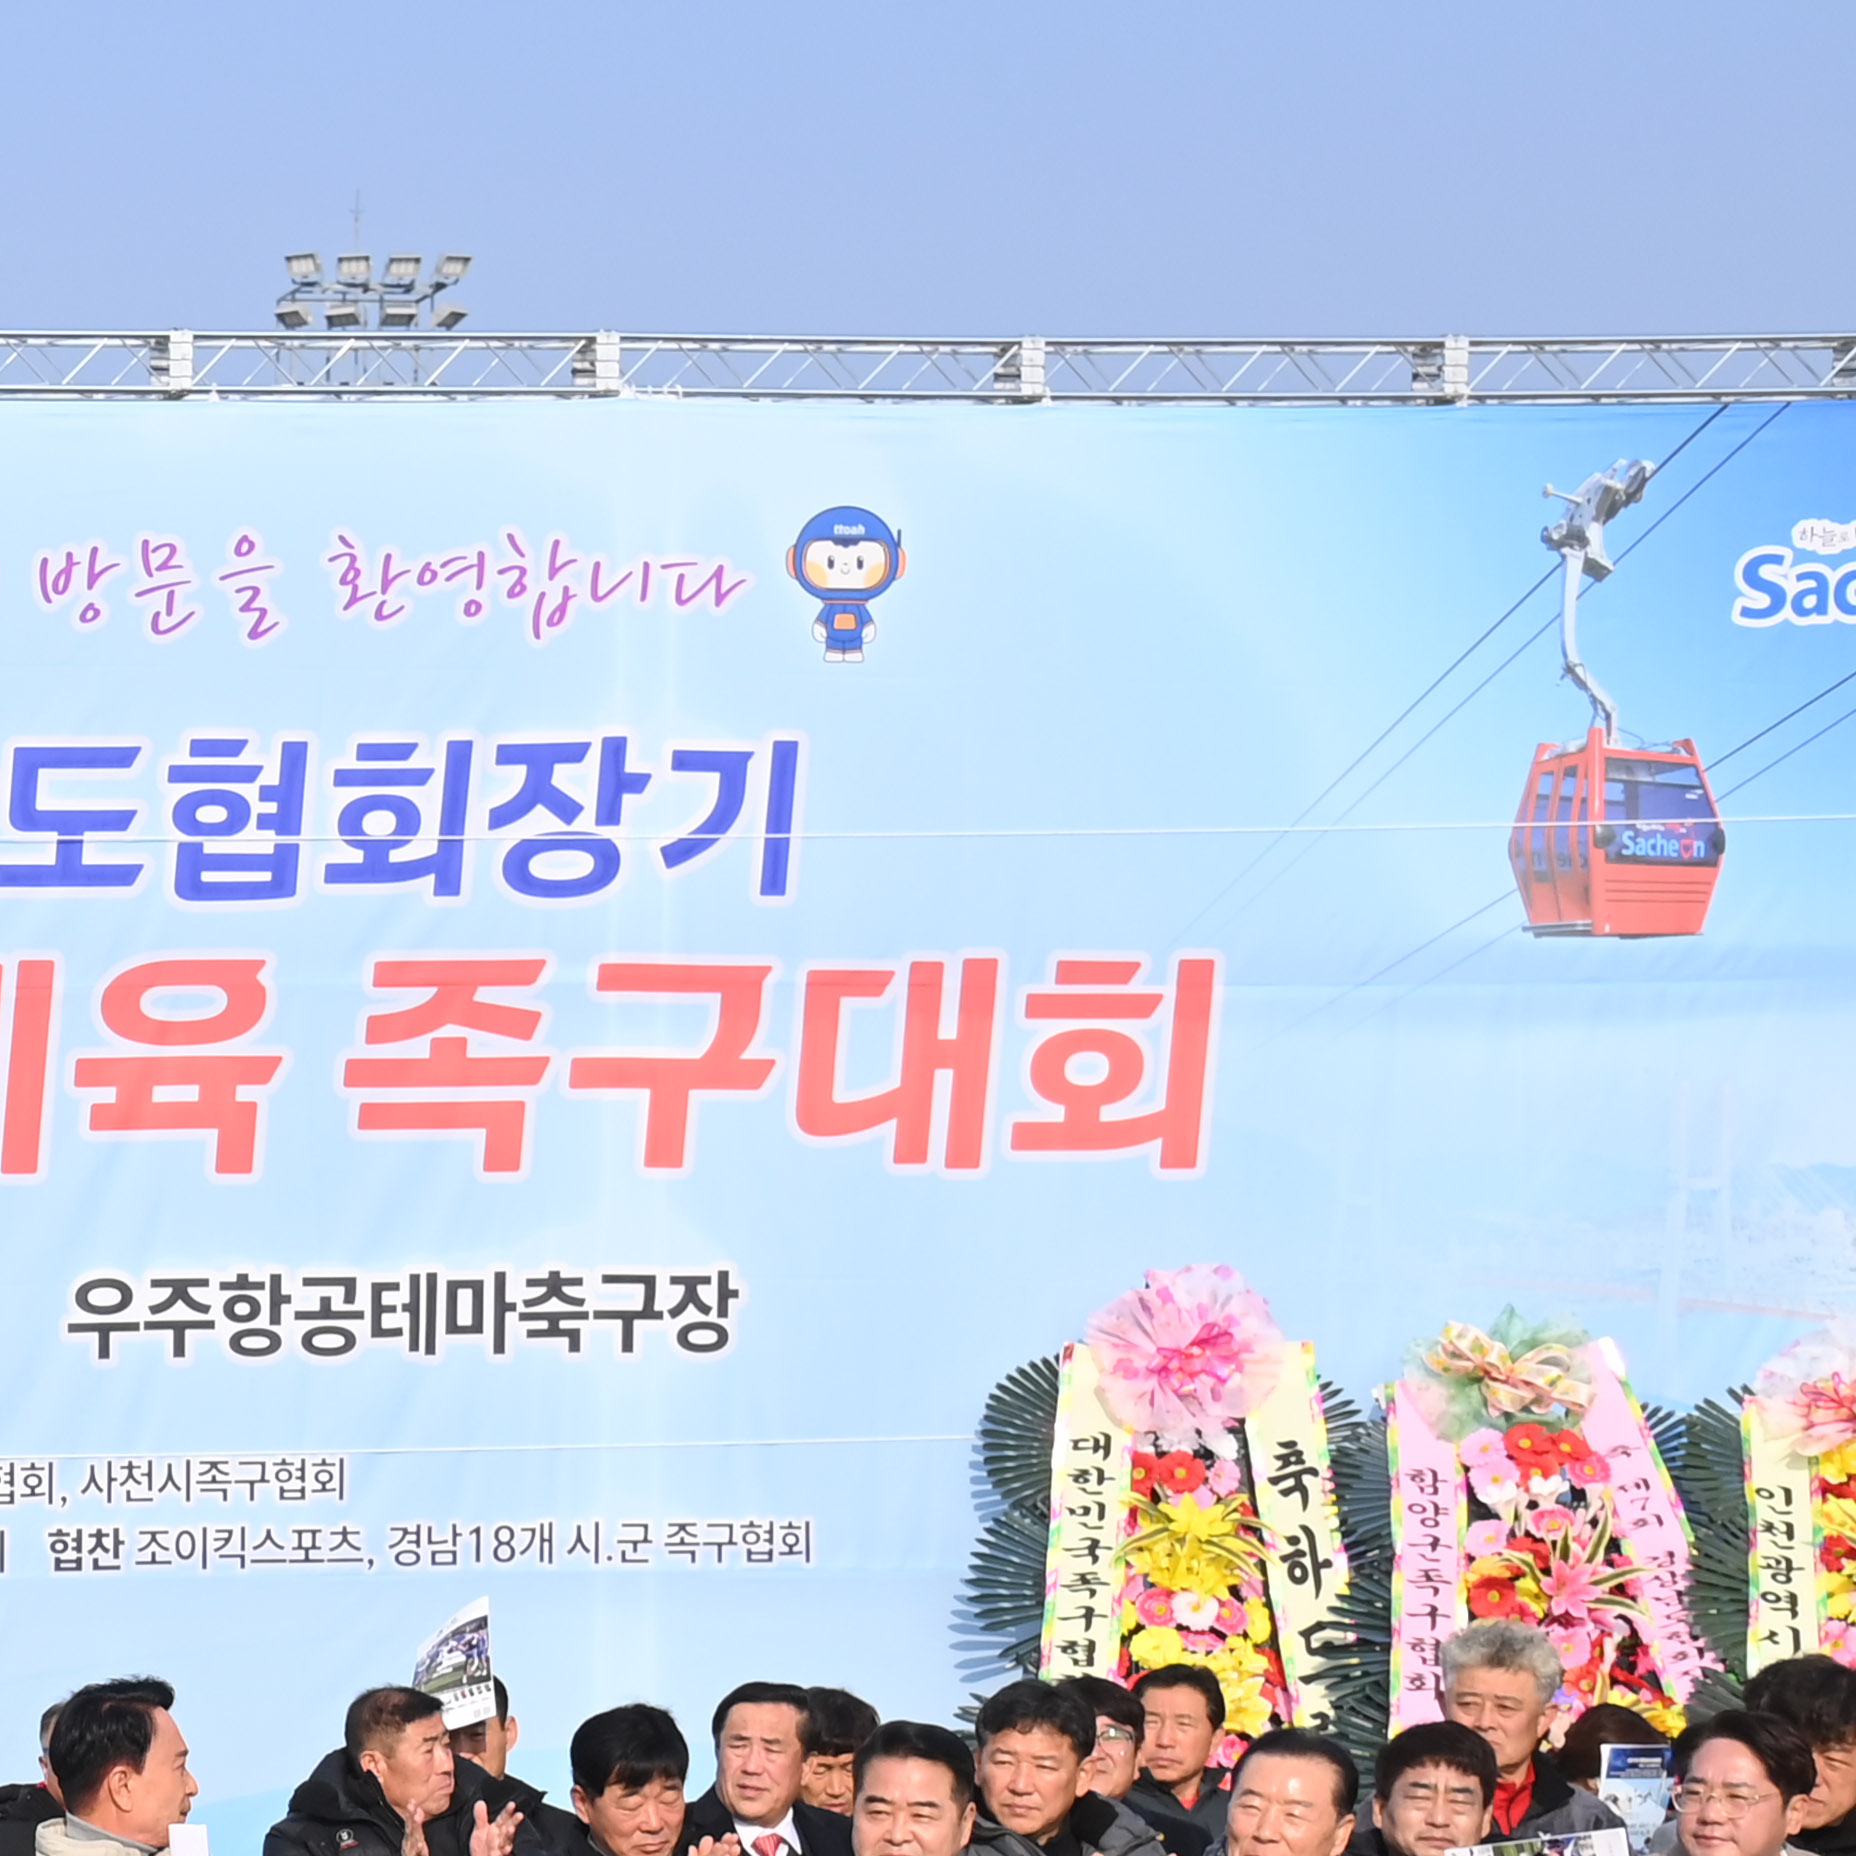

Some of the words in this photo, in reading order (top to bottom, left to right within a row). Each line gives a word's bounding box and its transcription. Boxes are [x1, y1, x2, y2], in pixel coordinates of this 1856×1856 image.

[37, 534, 286, 643] 방문을
[328, 533, 750, 640] 환영합니다
[343, 957, 1216, 1174] 족구대회
[67, 1270, 740, 1360] 우주항공테마축구장
[49, 1528, 126, 1571] 협찬
[138, 1526, 376, 1571] 조이킥스포츠,
[388, 1523, 555, 1566] 경남18개
[664, 1521, 814, 1564] 족구협회
[81, 1458, 345, 1503] 사천시족구협회
[1057, 1430, 1116, 1687] 대한민국족구협
[1405, 1466, 1453, 1701] 함양군족구협회
[1754, 1485, 1806, 1654] 인천광역시
